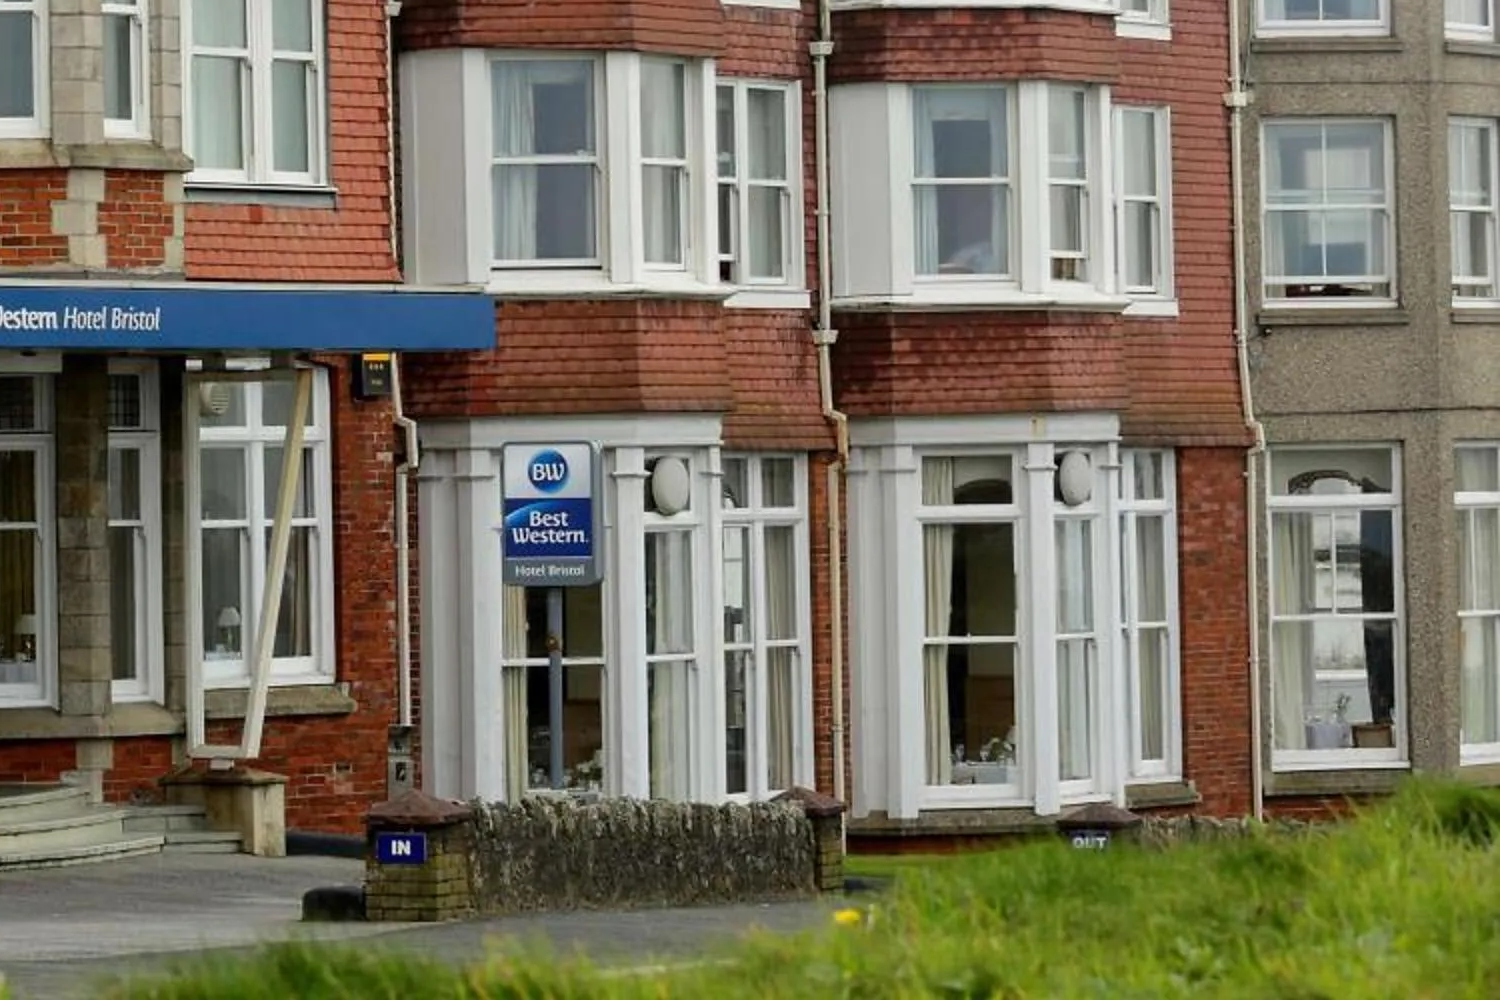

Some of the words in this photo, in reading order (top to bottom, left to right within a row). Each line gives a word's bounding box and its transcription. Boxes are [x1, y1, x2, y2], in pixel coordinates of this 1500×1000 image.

[63, 306, 107, 330] Hotel
[111, 307, 160, 331] Bristol
[532, 463, 565, 481] BW
[529, 511, 569, 527] Best
[515, 565, 546, 577] Hotel
[548, 565, 585, 577] Bristol
[391, 839, 411, 856] IN
[1072, 836, 1108, 850] OUT
